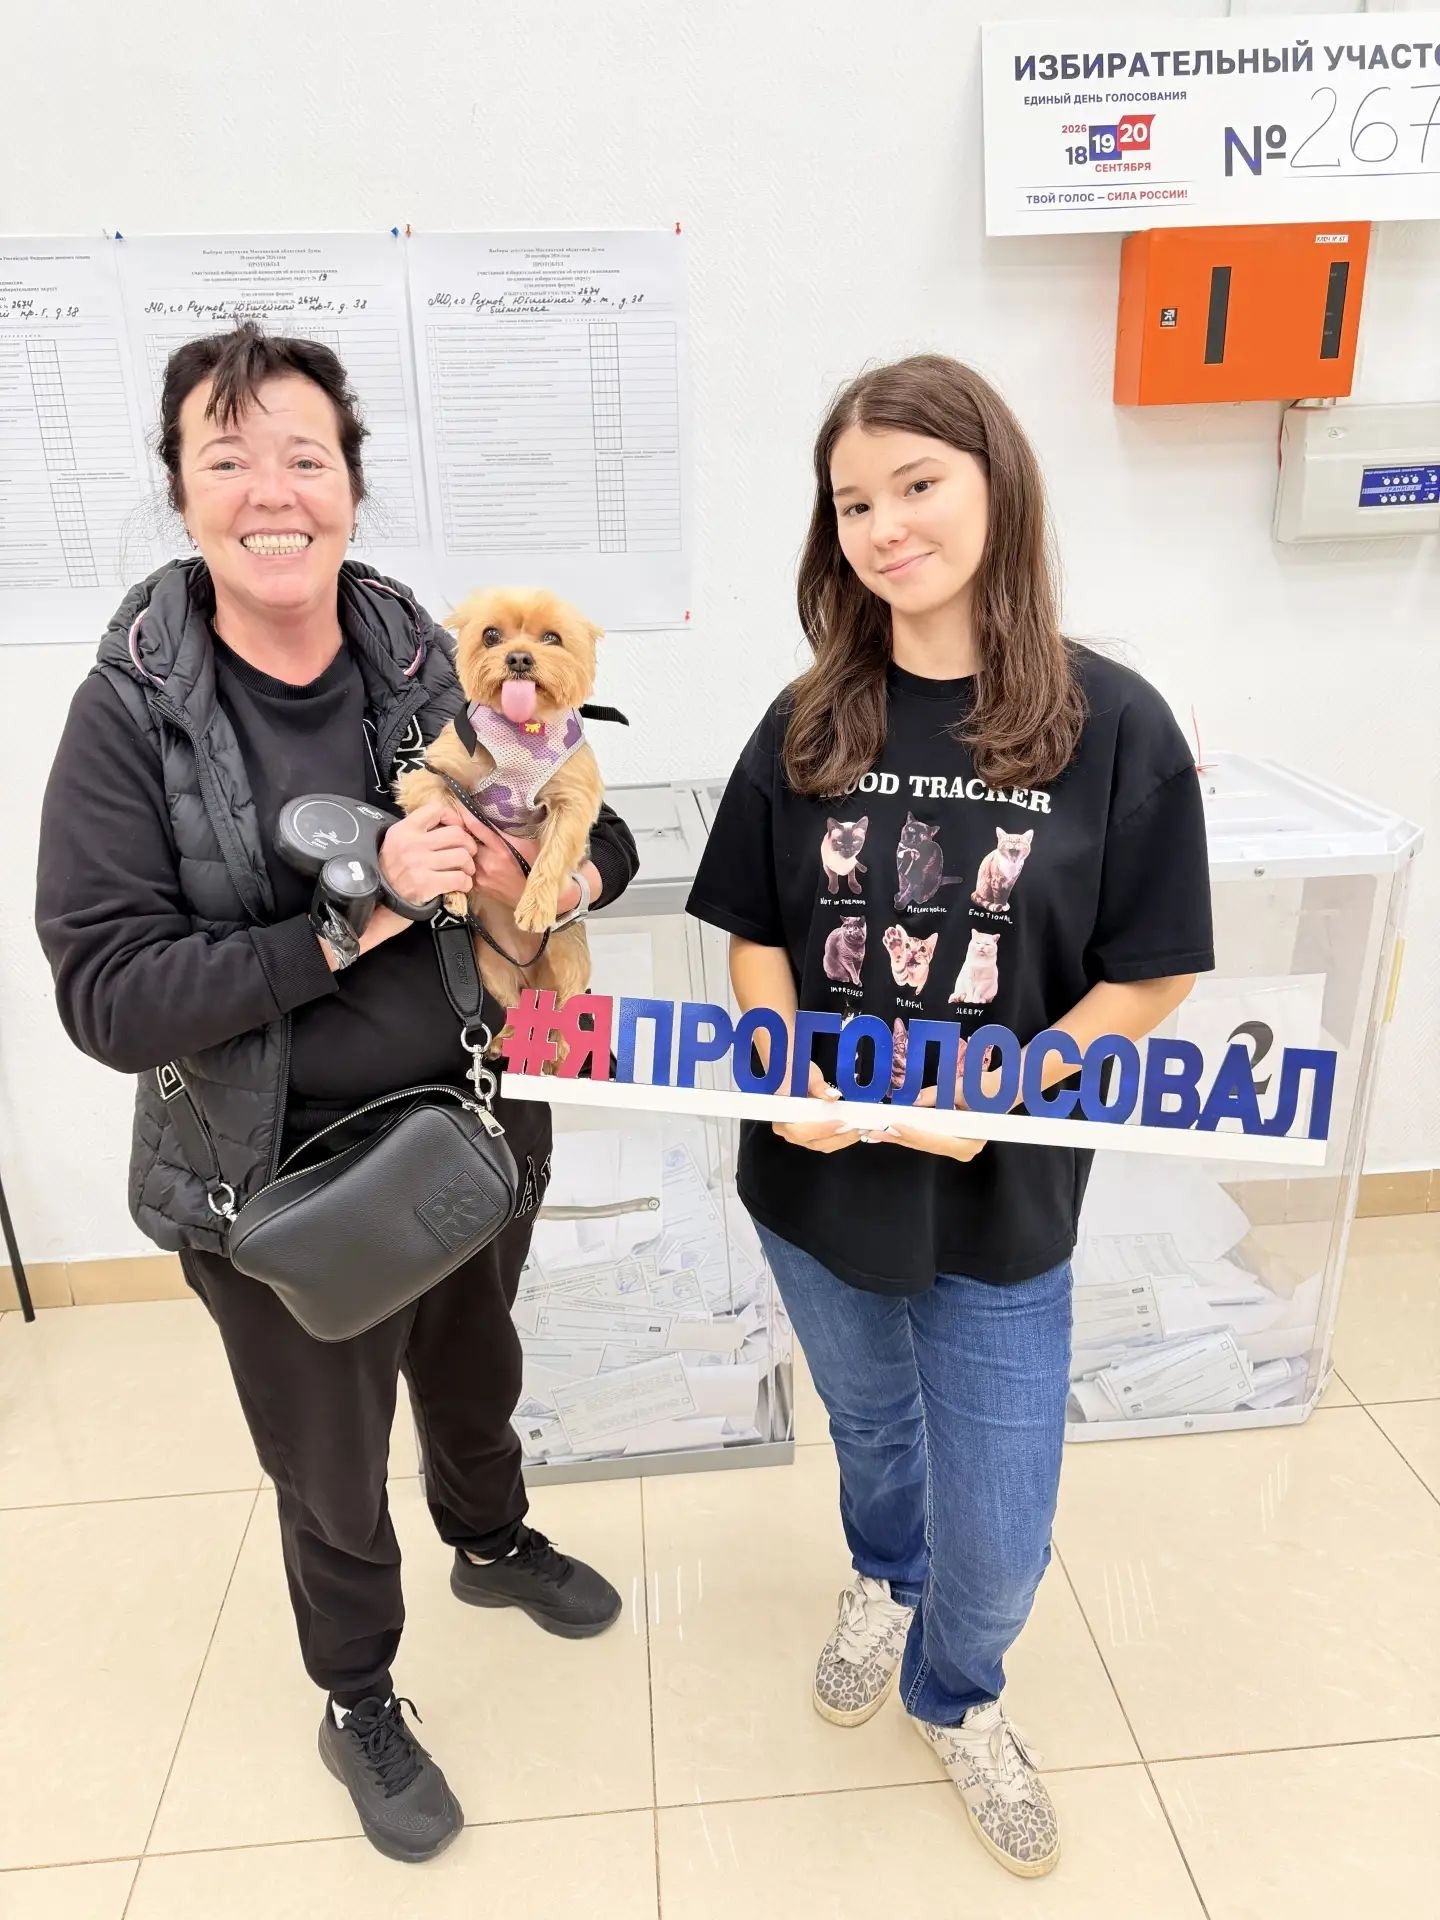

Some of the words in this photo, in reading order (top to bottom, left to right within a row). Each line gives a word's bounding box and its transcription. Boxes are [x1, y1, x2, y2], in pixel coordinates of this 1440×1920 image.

[1014, 39, 1313, 81] ИЗБИРАТЕЛЬНЫЙ
[1323, 43, 1440, 71] УЧАСТ
[1024, 92, 1071, 106] ЕДИНЫЙ
[1074, 94, 1103, 104] ДЕНЬ
[1105, 91, 1187, 102] ГОЛОСОВАНИЯ
[1061, 124, 1087, 134] 2026
[1065, 145, 1088, 165] 18
[1091, 133, 1116, 154] 19
[1119, 122, 1148, 143] 20
[1224, 124, 1287, 177] №
[1095, 162, 1151, 173] СЕНТЯБРЯ
[1026, 192, 1056, 204] ТВОЙ
[1058, 193, 1095, 203] ГОЛОС
[1107, 191, 1137, 201] СИЛА
[1139, 189, 1188, 200] РОССИИ!
[819, 772, 900, 798] OD
[820, 897, 832, 905] NOT
[968, 908, 1013, 924] EMOTIONAL
[830, 986, 864, 997] IMPRESSED
[955, 1006, 984, 1017] SLEEPY
[501, 988, 1338, 1140] #ЯПРОГОЛОСОВАЛ
